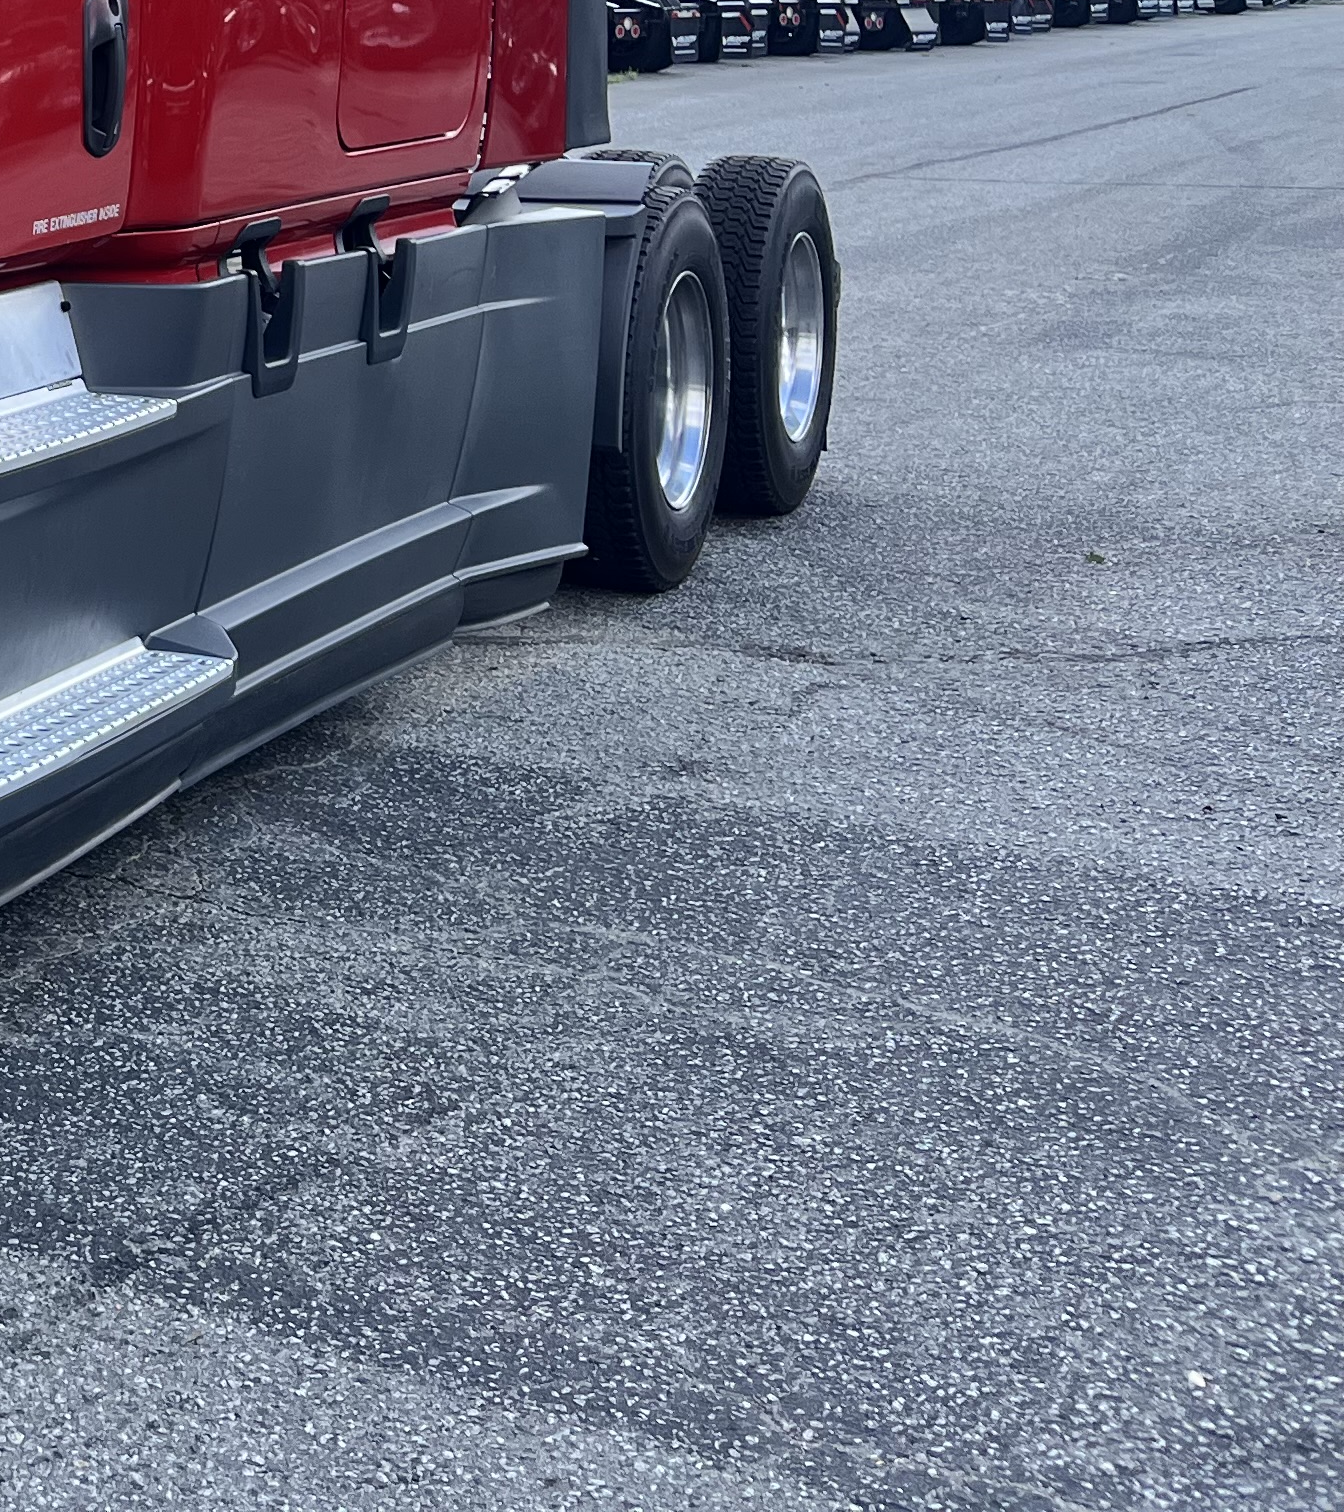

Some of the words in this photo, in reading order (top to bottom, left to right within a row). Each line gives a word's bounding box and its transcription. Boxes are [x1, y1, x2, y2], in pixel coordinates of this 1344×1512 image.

[31, 218, 50, 236] FIRE
[50, 208, 98, 232] EXTINGUISHER
[98, 203, 121, 221] INSIDE
